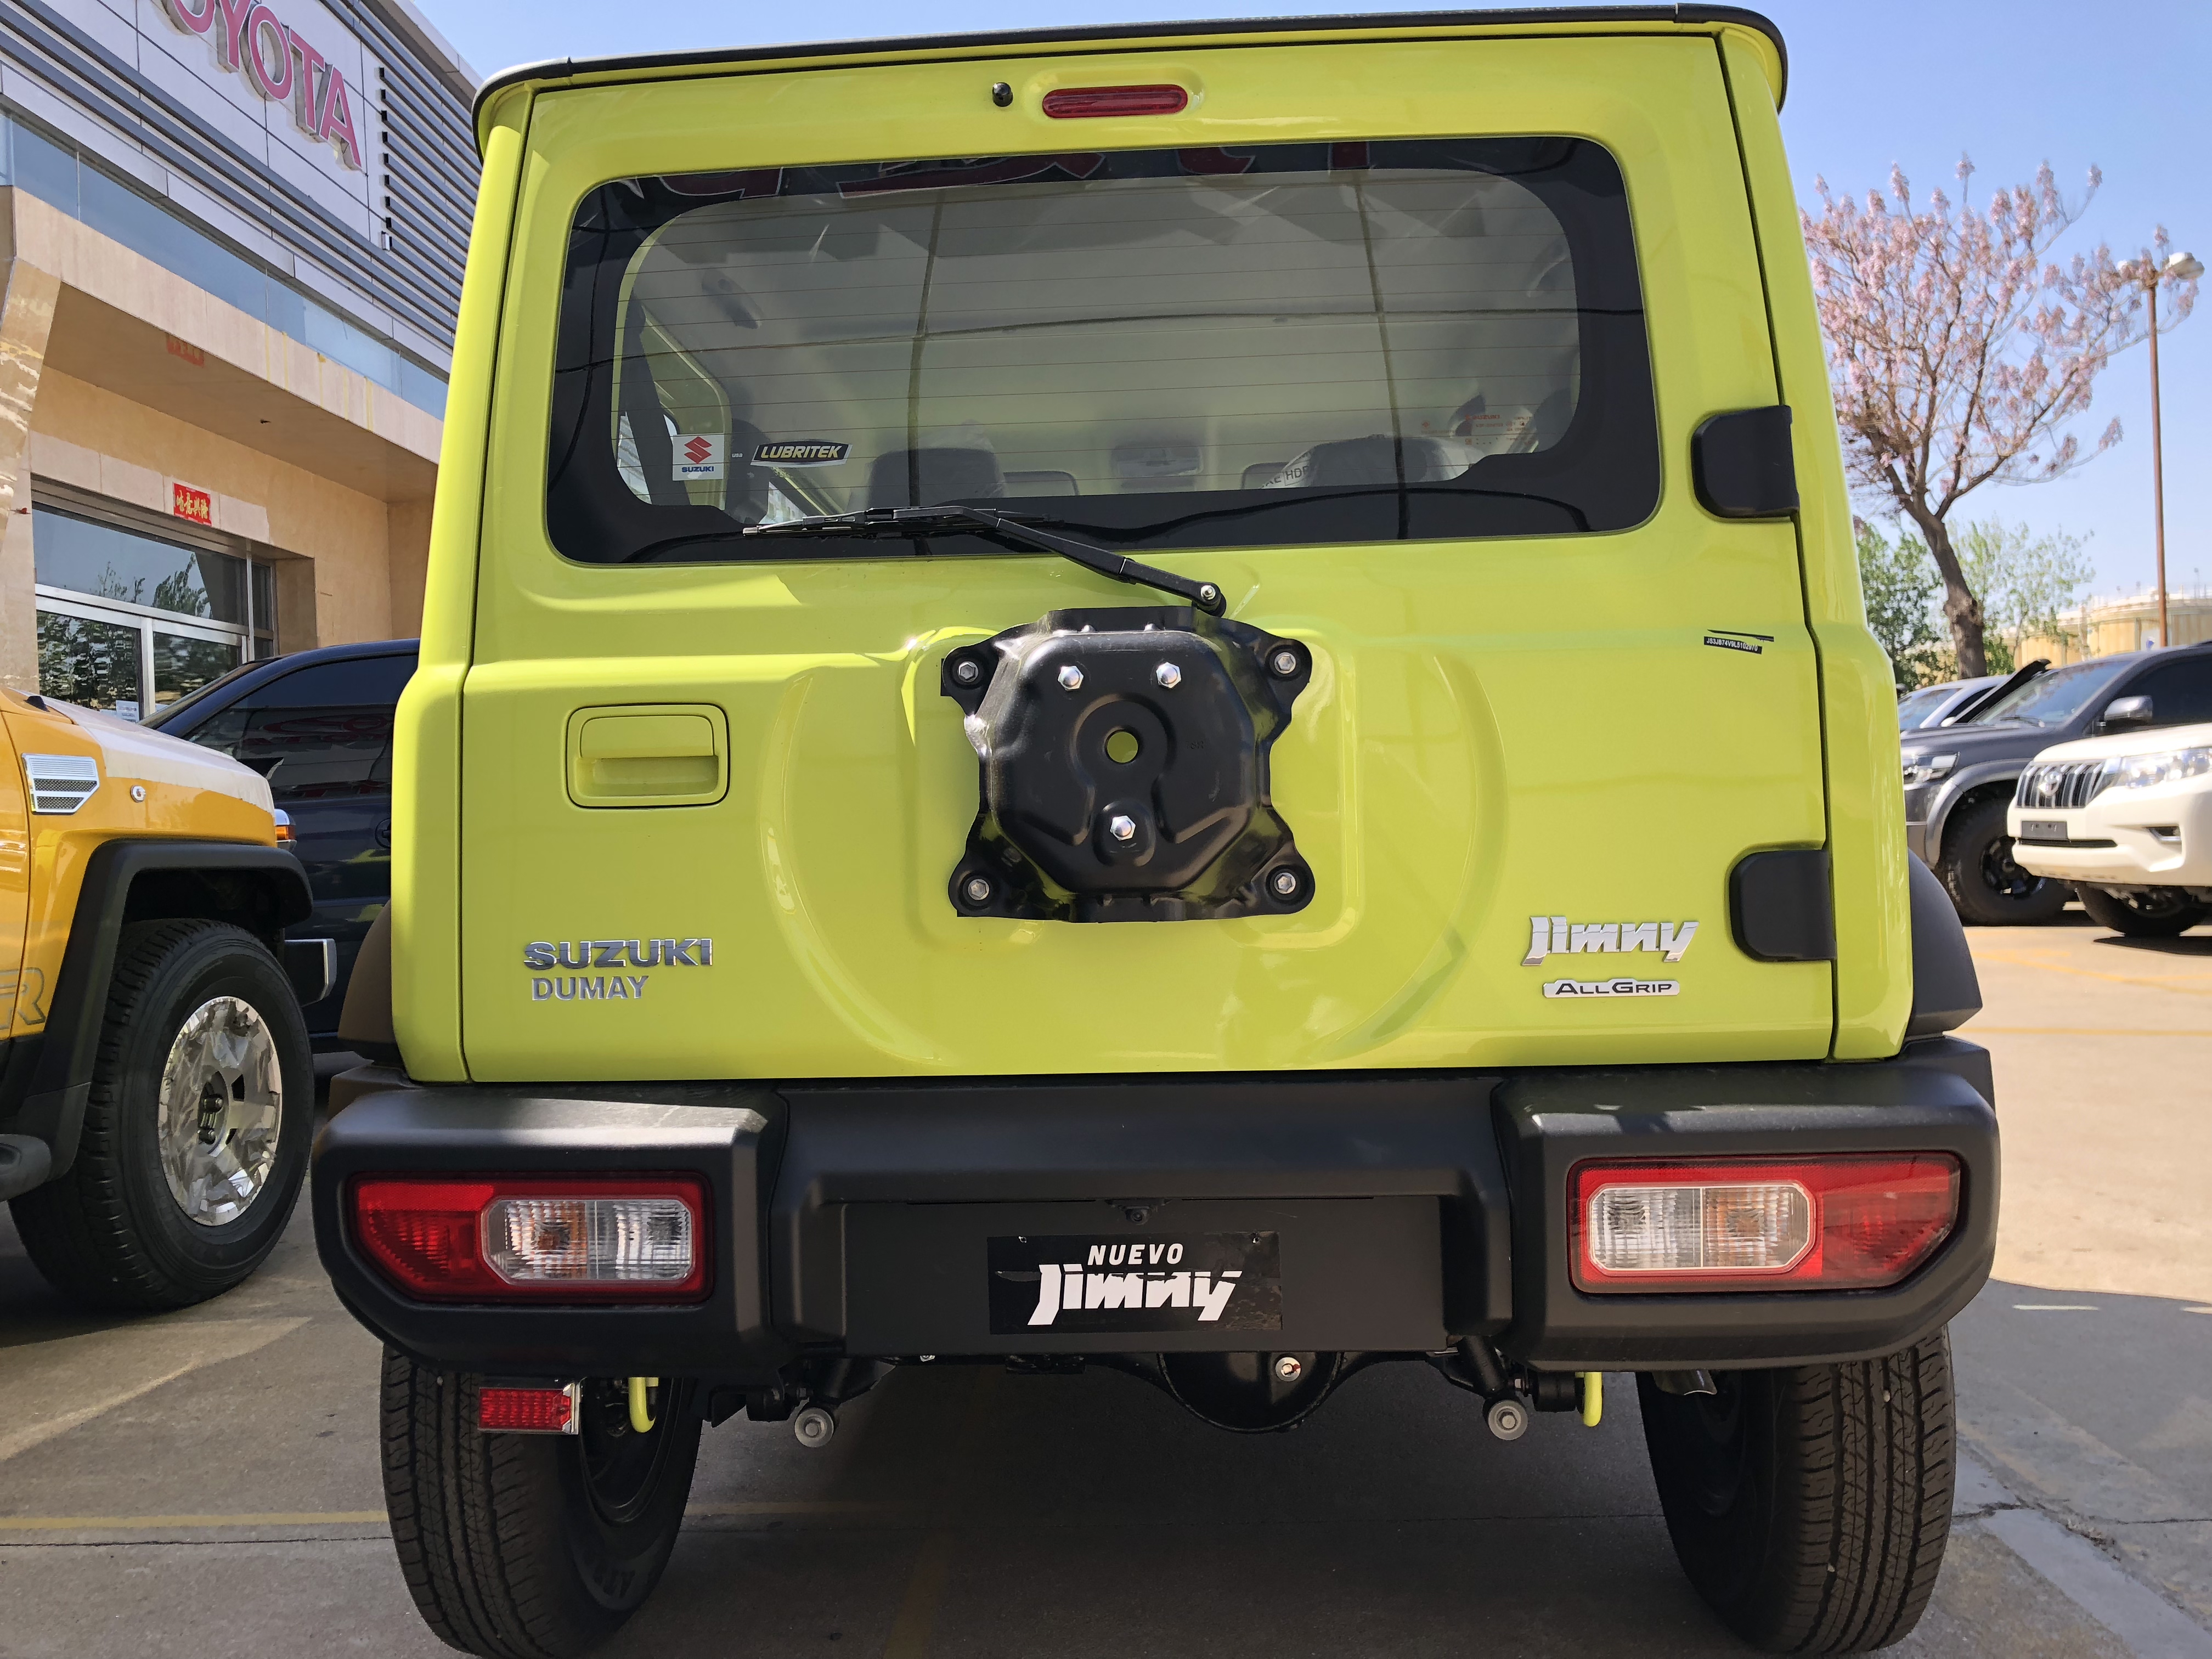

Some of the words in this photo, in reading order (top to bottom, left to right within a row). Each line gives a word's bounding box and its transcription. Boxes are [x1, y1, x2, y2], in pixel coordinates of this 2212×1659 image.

[760, 445, 843, 459] LUBRITEK
[524, 938, 713, 970] SUZUKI
[1521, 916, 1700, 966] Jimny
[532, 975, 648, 1001] DUMAY
[1087, 1243, 1183, 1266] NUEVO
[1027, 1263, 1243, 1325] Jimny
